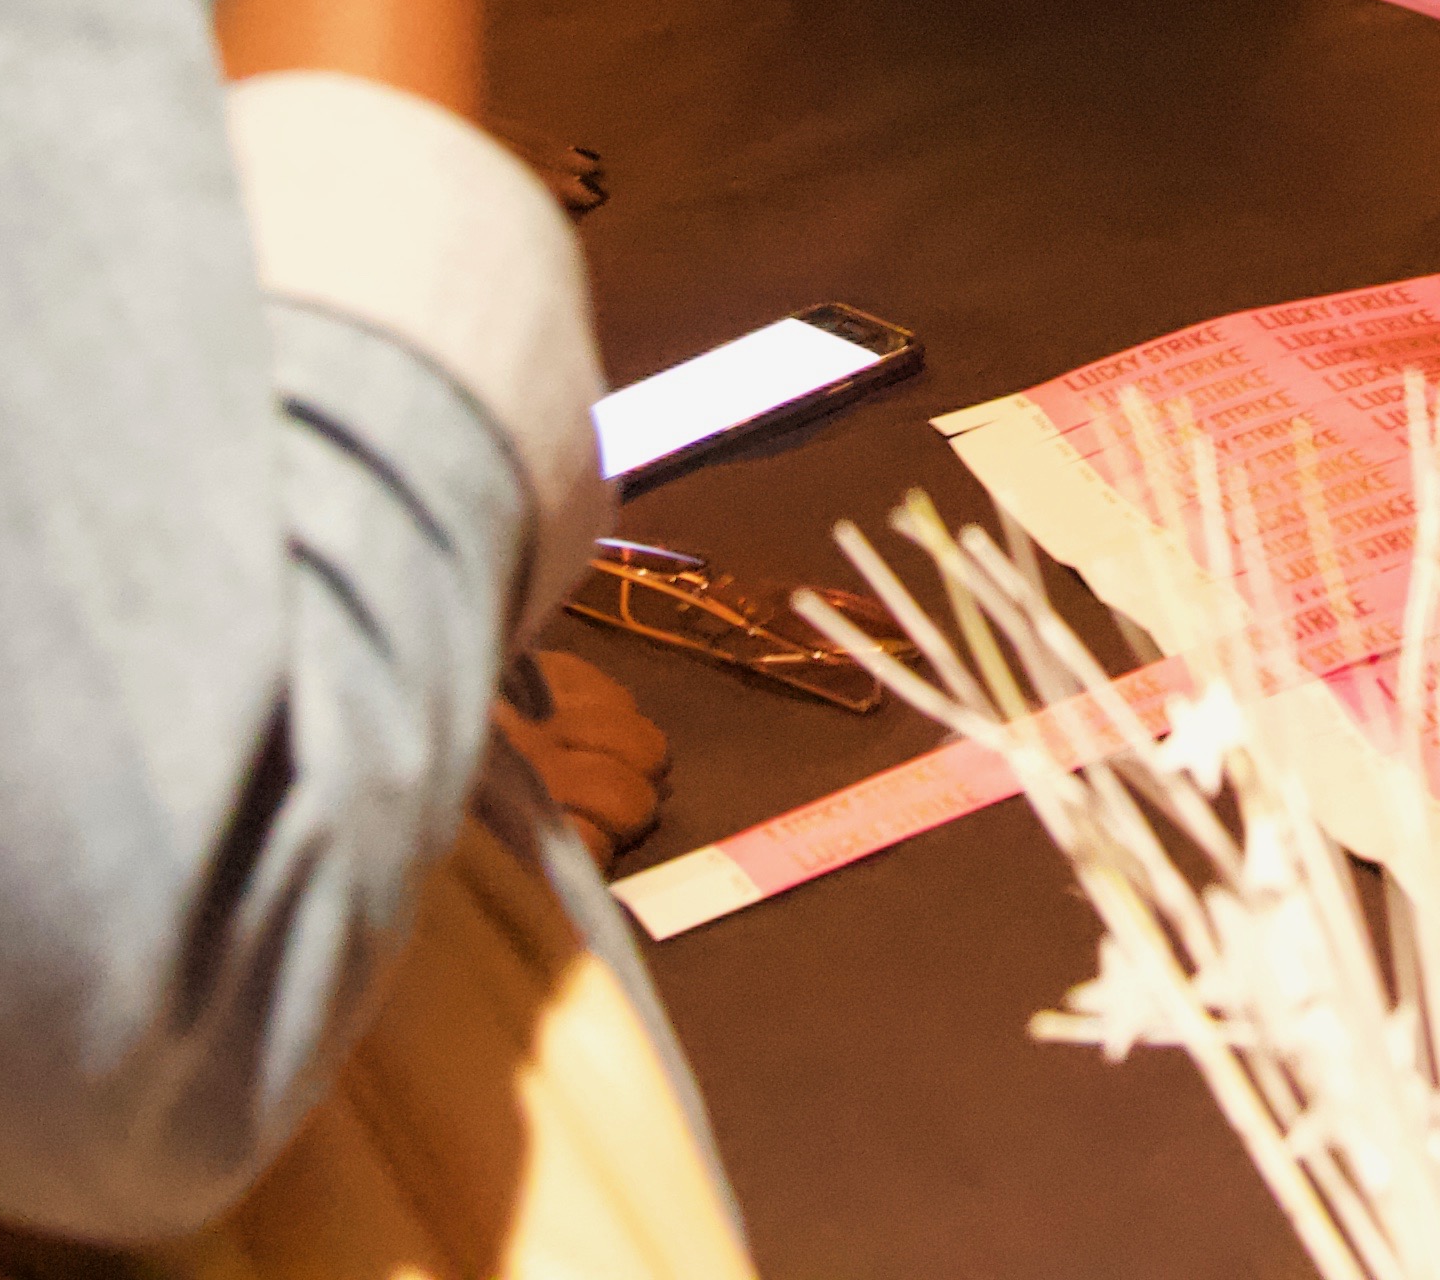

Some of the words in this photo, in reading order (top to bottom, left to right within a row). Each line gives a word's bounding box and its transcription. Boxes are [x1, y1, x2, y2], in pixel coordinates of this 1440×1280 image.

[1252, 301, 1332, 331] LUCKY
[1331, 284, 1419, 318] STRIKE
[1274, 320, 1360, 352] LUCKY
[1297, 340, 1380, 372] LUCKY
[1062, 353, 1142, 393] LUCKY
[1140, 323, 1229, 365] STRIKE
[1163, 343, 1252, 386] STRIKE
[1321, 360, 1404, 394] LUCKY
[1208, 387, 1299, 430] STRIKE
